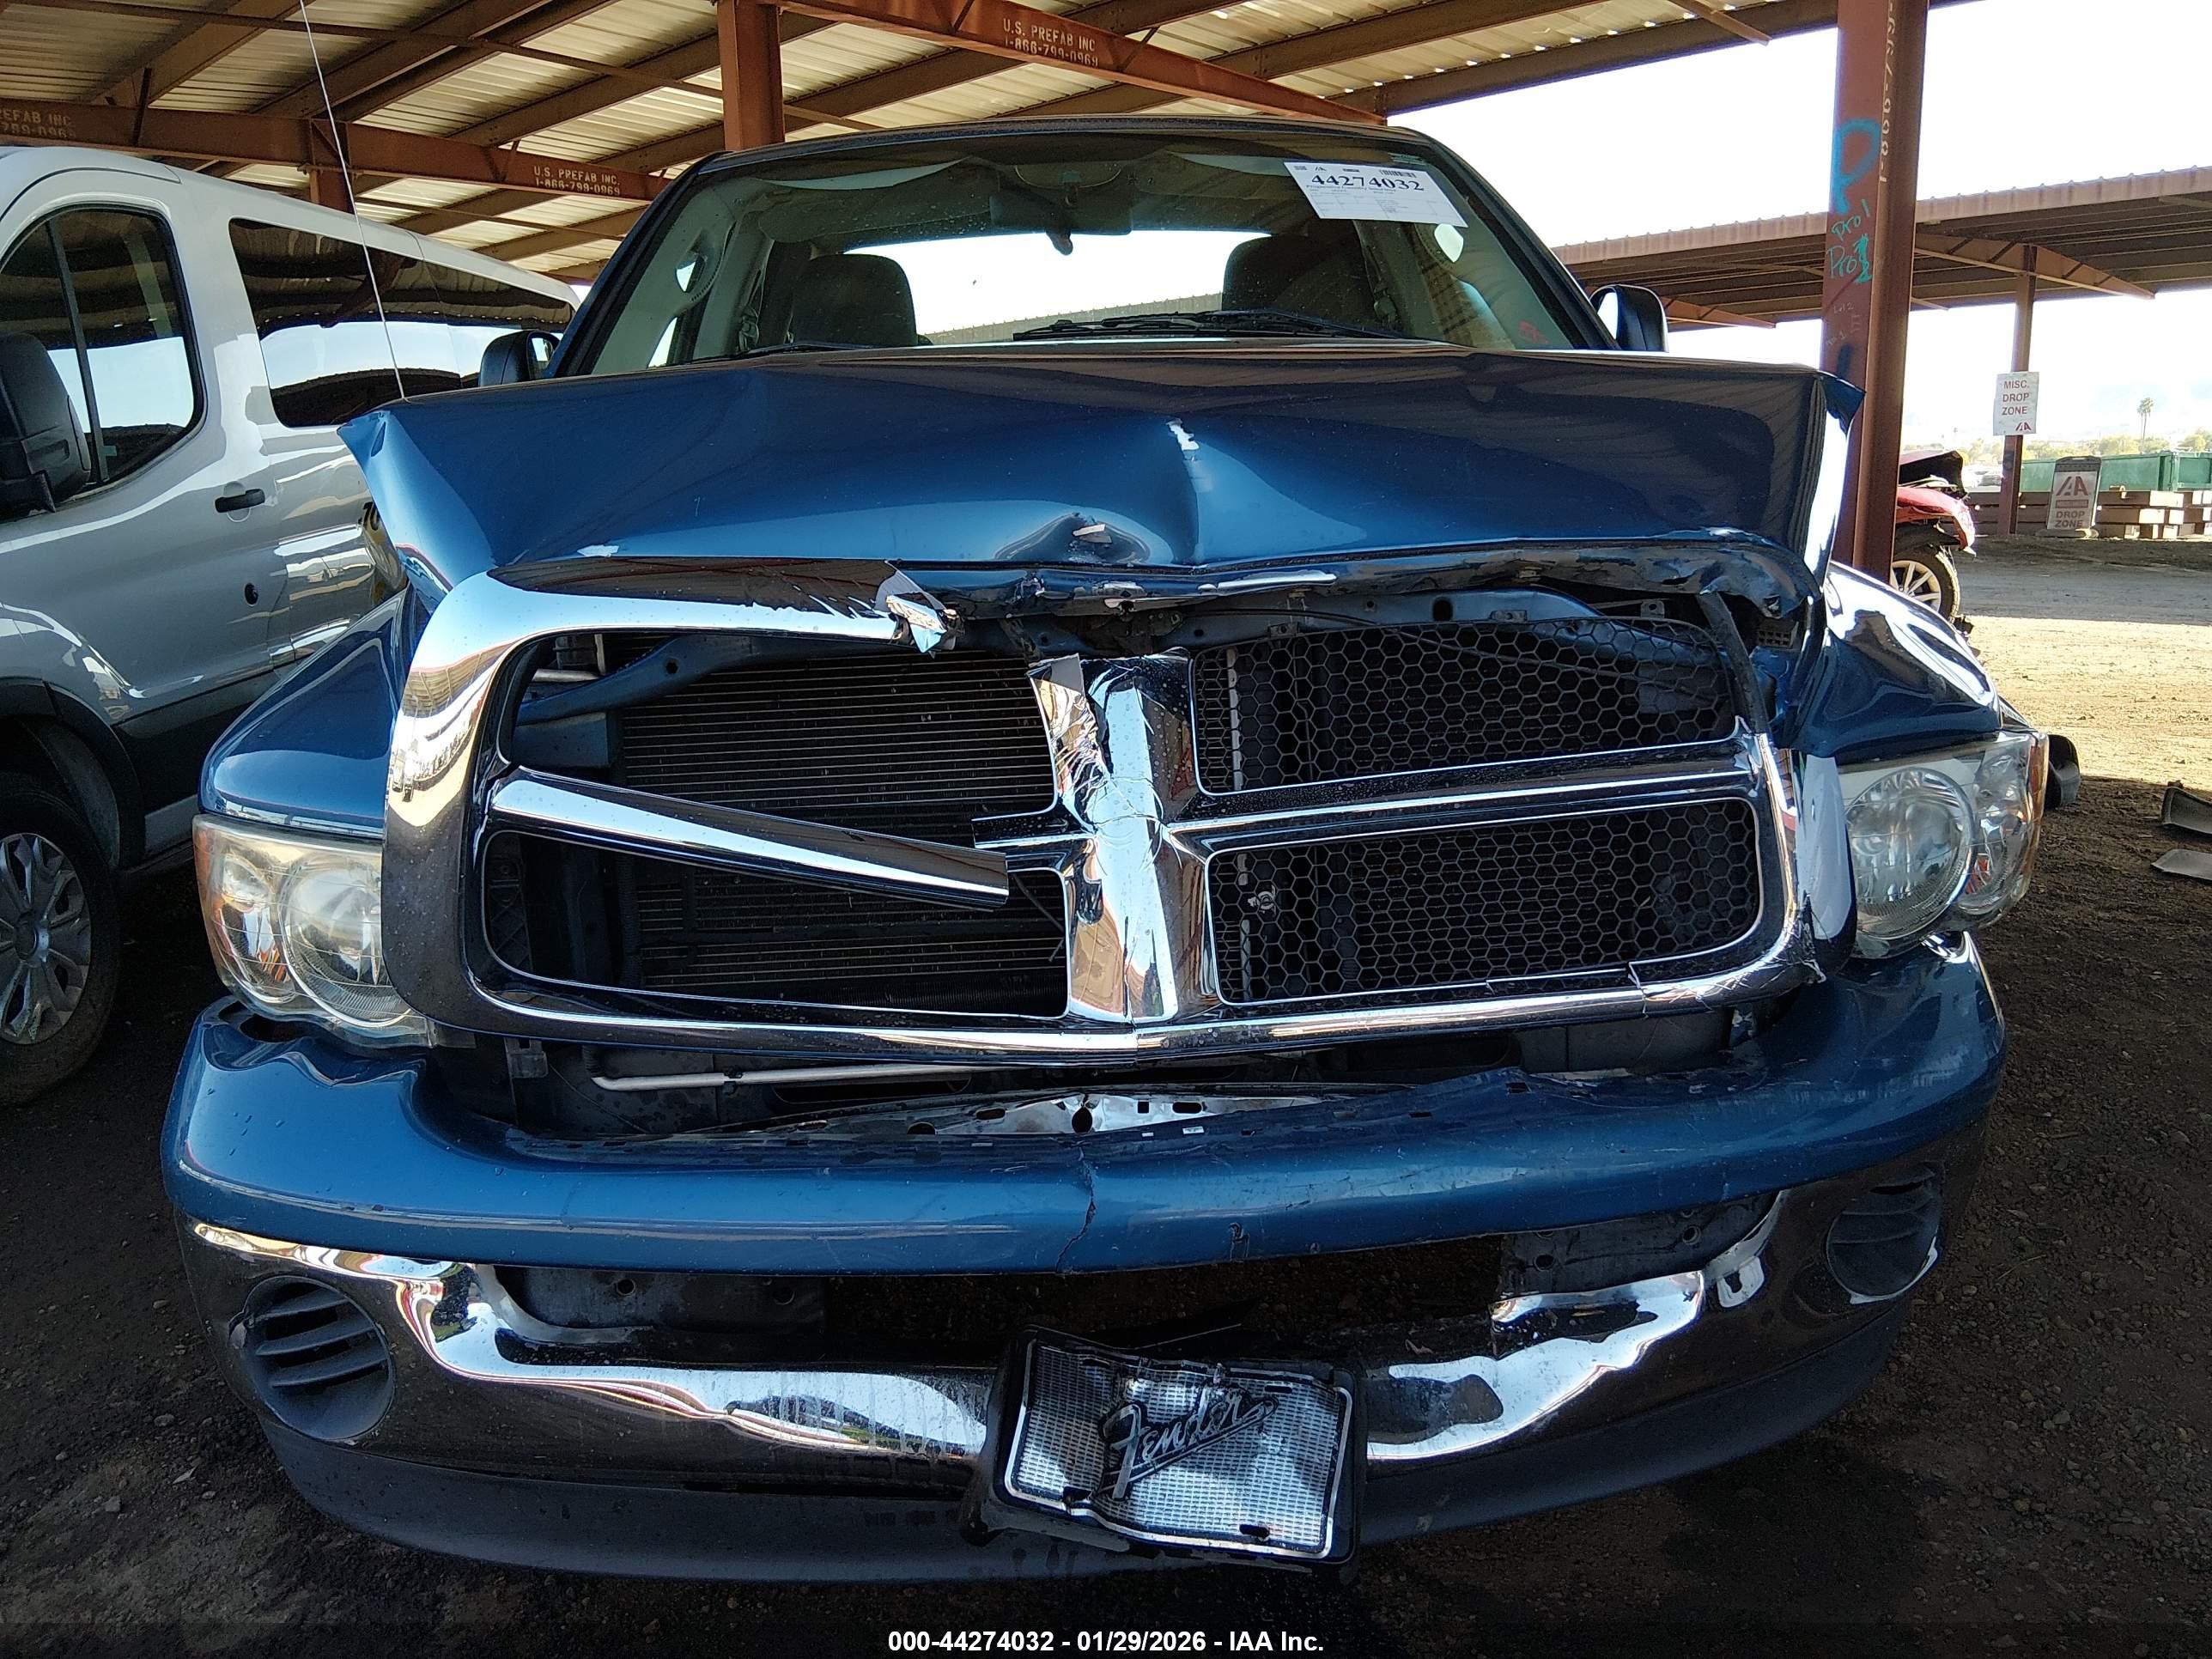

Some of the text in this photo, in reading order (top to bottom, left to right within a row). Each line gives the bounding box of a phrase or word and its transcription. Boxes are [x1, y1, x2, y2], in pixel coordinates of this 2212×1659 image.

[1003, 18, 1096, 52] U.S. PREFAB INC
[534, 166, 620, 185] U.S. PREFAB INC.
[1311, 174, 1425, 191] 44274032
[536, 177, 620, 196] 1-866-799-0969
[2003, 380, 2030, 389] MISC.
[2002, 392, 2030, 403] DROP
[2002, 406, 2027, 416] ZONE
[2056, 511, 2085, 520] DROP
[2054, 520, 2083, 528] ZONE
[1103, 1383, 1274, 1499] Fender
